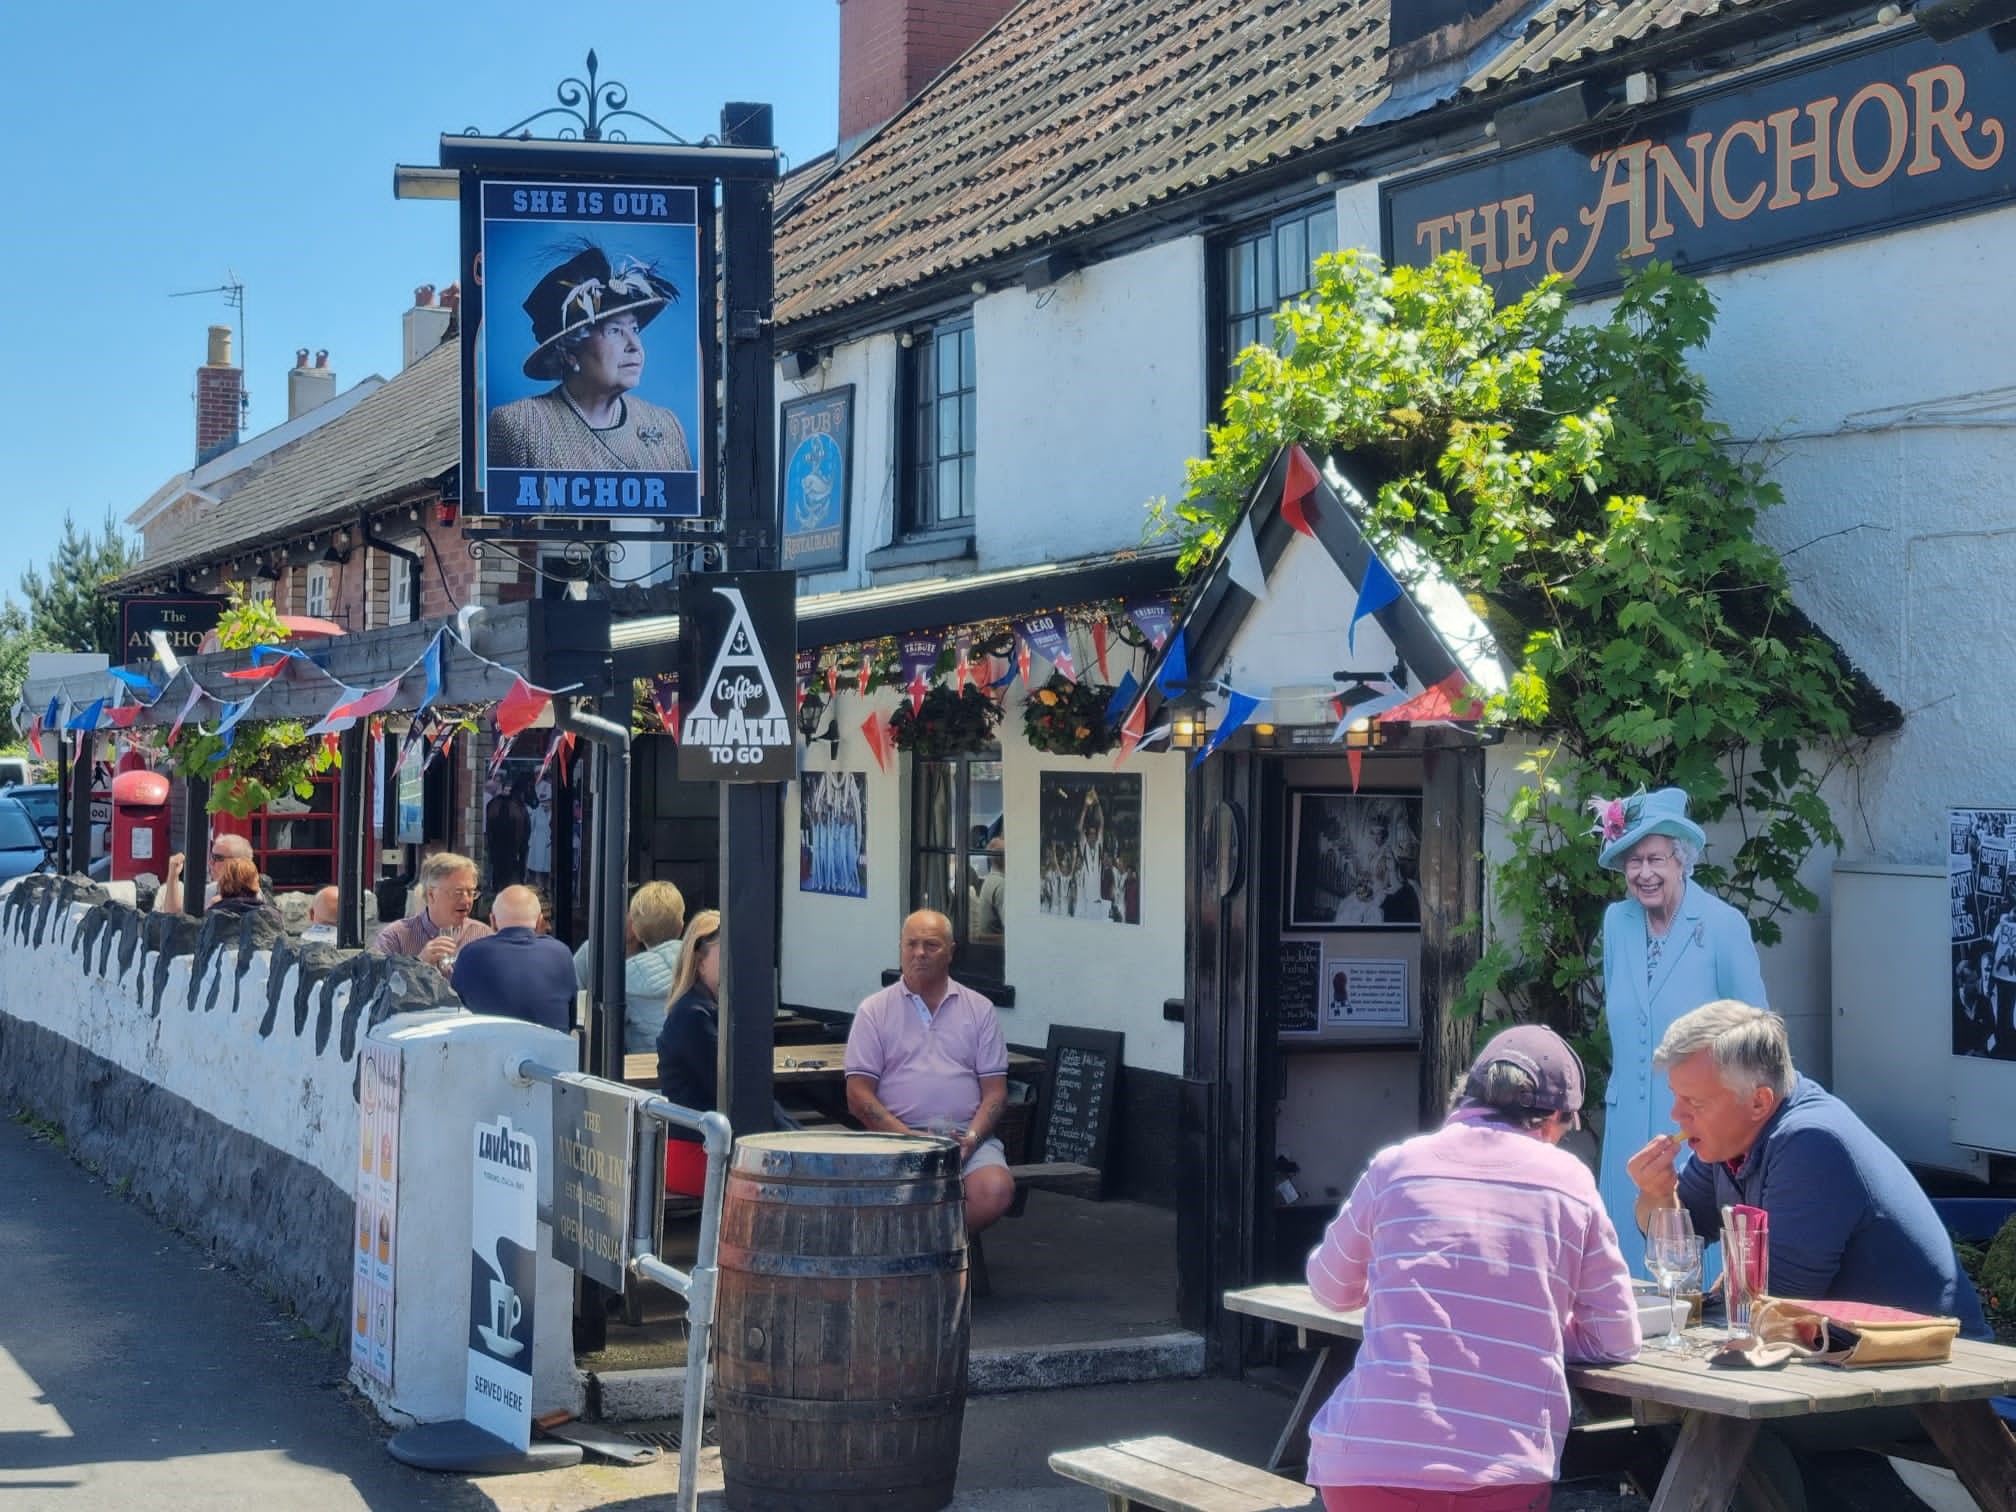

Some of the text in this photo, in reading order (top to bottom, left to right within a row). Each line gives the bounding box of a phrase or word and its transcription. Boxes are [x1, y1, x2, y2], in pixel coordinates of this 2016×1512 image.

[1416, 63, 2004, 282] THE ANCHOR
[513, 190, 669, 217] SHE IS OUR
[801, 411, 832, 441] PUB
[516, 476, 667, 508] ANCHOR
[160, 609, 186, 622] The
[1026, 617, 1054, 634] LEAD
[128, 630, 207, 647] ANCHO
[904, 640, 937, 654] TRIBUTE
[716, 674, 763, 710] Coffee
[682, 709, 791, 745] LAVAZZA
[709, 746, 763, 764] TO GO
[91, 809, 108, 817] ool
[1952, 871, 1973, 896] PORT
[584, 1110, 601, 1134] THE
[479, 1126, 532, 1173] LAVAZZA
[558, 1135, 608, 1180] ANCHOR
[583, 1231, 594, 1251] AS
[474, 1375, 523, 1413] SERVED HERE
